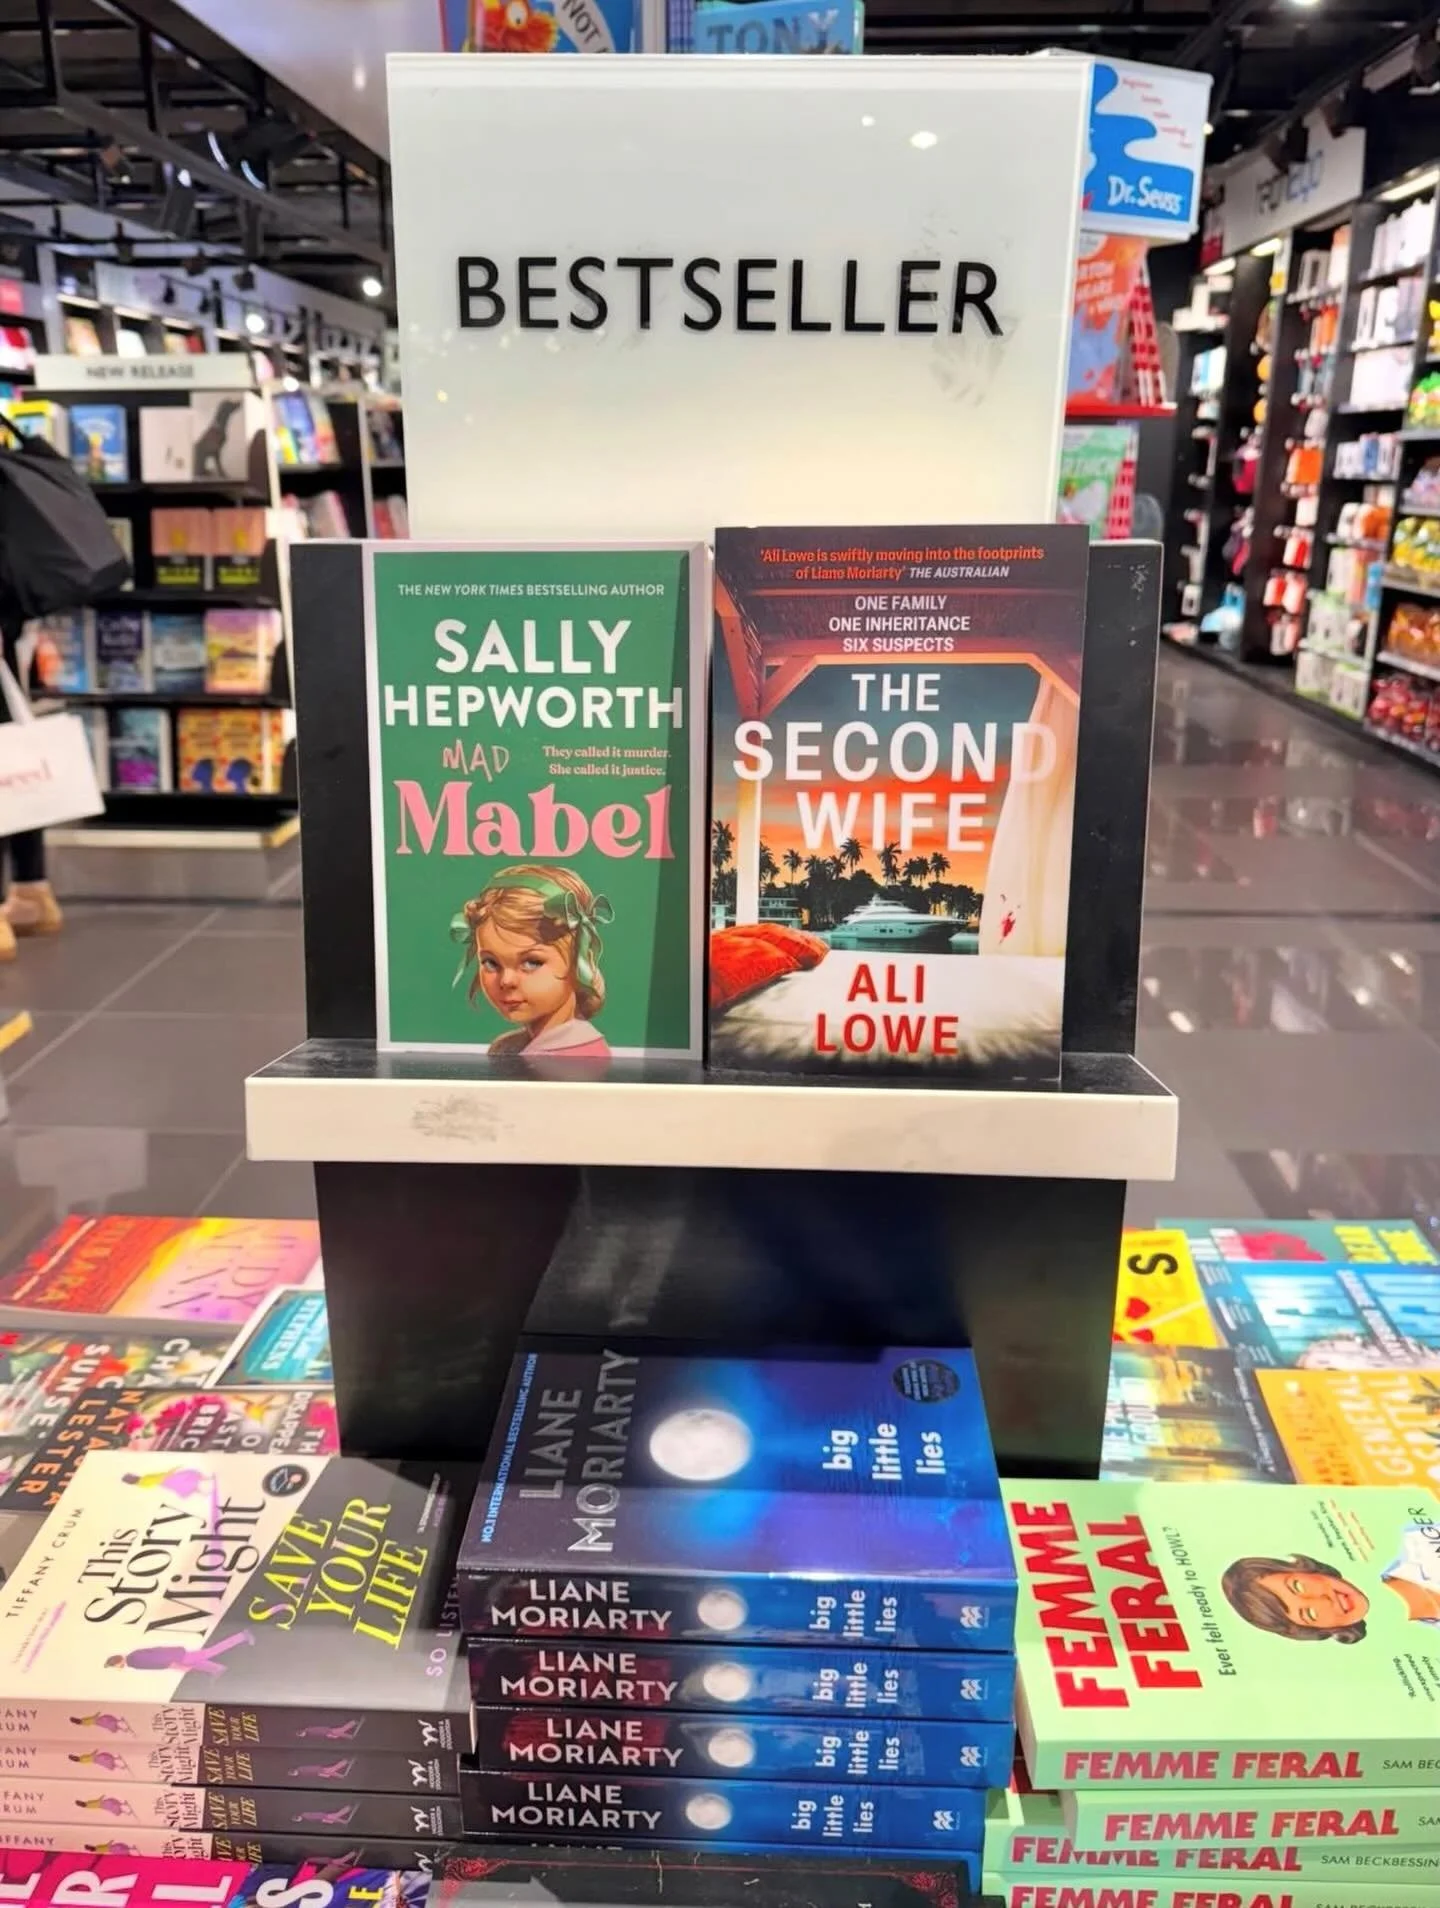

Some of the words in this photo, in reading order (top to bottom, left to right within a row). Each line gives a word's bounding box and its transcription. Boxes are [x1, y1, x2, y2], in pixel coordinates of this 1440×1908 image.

[562, 0, 601, 45] NOT
[707, 9, 840, 53] TONY
[1108, 175, 1135, 206] Dr.
[1138, 176, 1183, 215] Seuss
[458, 256, 1002, 334] BESTSELLER
[87, 366, 124, 379] NEW
[131, 365, 194, 379] RELEASE
[782, 548, 814, 563] Lowe
[816, 548, 828, 562] is
[829, 547, 873, 564] swiftly
[875, 548, 924, 564] moving
[925, 547, 950, 562] into
[952, 547, 975, 561] the
[977, 546, 1045, 562] footprints
[795, 567, 809, 580] of
[811, 567, 845, 580] Liane
[908, 566, 932, 579] THE
[933, 566, 1009, 579] AUSTRALIAN
[398, 584, 422, 596] THE
[425, 584, 452, 596] NEW
[454, 584, 486, 596] YORK
[489, 584, 524, 596] TIMES
[527, 584, 608, 596] BESTSELLING
[610, 584, 665, 596] AUTHOR
[855, 596, 888, 610] ONE
[891, 595, 947, 611] FAMILY
[828, 617, 862, 632] ONE
[865, 616, 971, 632] INHERITANCE
[434, 619, 632, 674] SALLY
[842, 638, 869, 653] SIX
[872, 637, 955, 653] SUSPECTS
[384, 685, 683, 729] HEPWORTH
[851, 673, 941, 711] THE
[442, 739, 510, 783] MAD
[542, 746, 573, 760] They
[574, 746, 610, 759] called
[611, 747, 622, 759] it
[623, 747, 672, 760] murder.
[549, 763, 572, 776] She
[573, 763, 609, 776] called
[611, 763, 621, 776] it
[622, 763, 666, 777] justice.
[732, 720, 1057, 783] SECOND
[393, 780, 675, 859] Mabel
[796, 792, 987, 852] WIFE
[847, 963, 925, 1004] ALI
[816, 1014, 959, 1056] LOWE
[29, 1343, 110, 1440] SUNSE
[16, 1399, 107, 1495] LESTER
[488, 1444, 516, 1519] INTERNATIONAL
[506, 1387, 530, 1443] BESTSELLING
[521, 1353, 539, 1387] AUTHOR
[519, 1389, 582, 1499] LIANE
[567, 1349, 640, 1552] MORIARTY
[822, 1430, 859, 1470] big
[869, 1423, 902, 1481] little
[916, 1431, 946, 1475] lies
[5, 1555, 55, 1618] TIFFANY
[52, 1507, 84, 1548] CRUM
[77, 1528, 138, 1583] This
[84, 1503, 207, 1625] Story
[305, 1498, 392, 1621] YOUR
[1162, 1526, 1192, 1567] HOWL?
[144, 1496, 266, 1637] Might
[248, 1513, 332, 1631] SAVE
[1184, 1569, 1197, 1581] to
[353, 1539, 428, 1650] LIFE
[530, 1579, 630, 1603] LIANE
[1010, 1501, 1130, 1707] FEMME
[1086, 1515, 1203, 1689] FERAL
[1186, 1585, 1213, 1620] ready
[491, 1606, 672, 1631] MORIARTY
[810, 1596, 836, 1630] big
[843, 1590, 866, 1637] little
[875, 1596, 897, 1632] lies
[1201, 1622, 1223, 1643] felt
[426, 1647, 447, 1678] SO
[539, 1650, 637, 1674] LIANE
[1218, 1648, 1237, 1676] Ever
[501, 1676, 678, 1701] MORIARTY
[813, 1668, 839, 1701] big
[845, 1662, 868, 1708] little
[877, 1669, 899, 1703] lies
[162, 1705, 179, 1745] Story
[208, 1706, 229, 1746] SAVE
[241, 1711, 260, 1742] LIFE
[547, 1718, 643, 1741] LIANE
[157, 1744, 174, 1783] Story
[203, 1746, 224, 1784] SAVE
[236, 1750, 254, 1781] LIFE
[509, 1743, 684, 1768] MORIARTY
[815, 1736, 841, 1767] big
[847, 1730, 869, 1774] little
[878, 1737, 899, 1770] lies
[1063, 1751, 1220, 1780] FEMME
[1232, 1751, 1363, 1779] FERAL
[1383, 1759, 1412, 1770] SAM
[1418, 1759, 1440, 1770] BEC
[164, 1789, 181, 1827] Story
[208, 1791, 228, 1829] SAVE
[240, 1796, 258, 1827] LIFE
[528, 1782, 622, 1804] LIANE
[491, 1805, 662, 1830] MORIARTY
[791, 1800, 817, 1830] big
[822, 1795, 844, 1837] little
[853, 1801, 874, 1833] lies
[1105, 1811, 1257, 1842] FEMME
[1271, 1809, 1399, 1838] FERAL
[1174, 1846, 1302, 1872] FERAL
[1321, 1855, 1350, 1866] SAM
[1355, 1855, 1440, 1868] BECKBESSIN
[1010, 1886, 1158, 1908] FEMME
